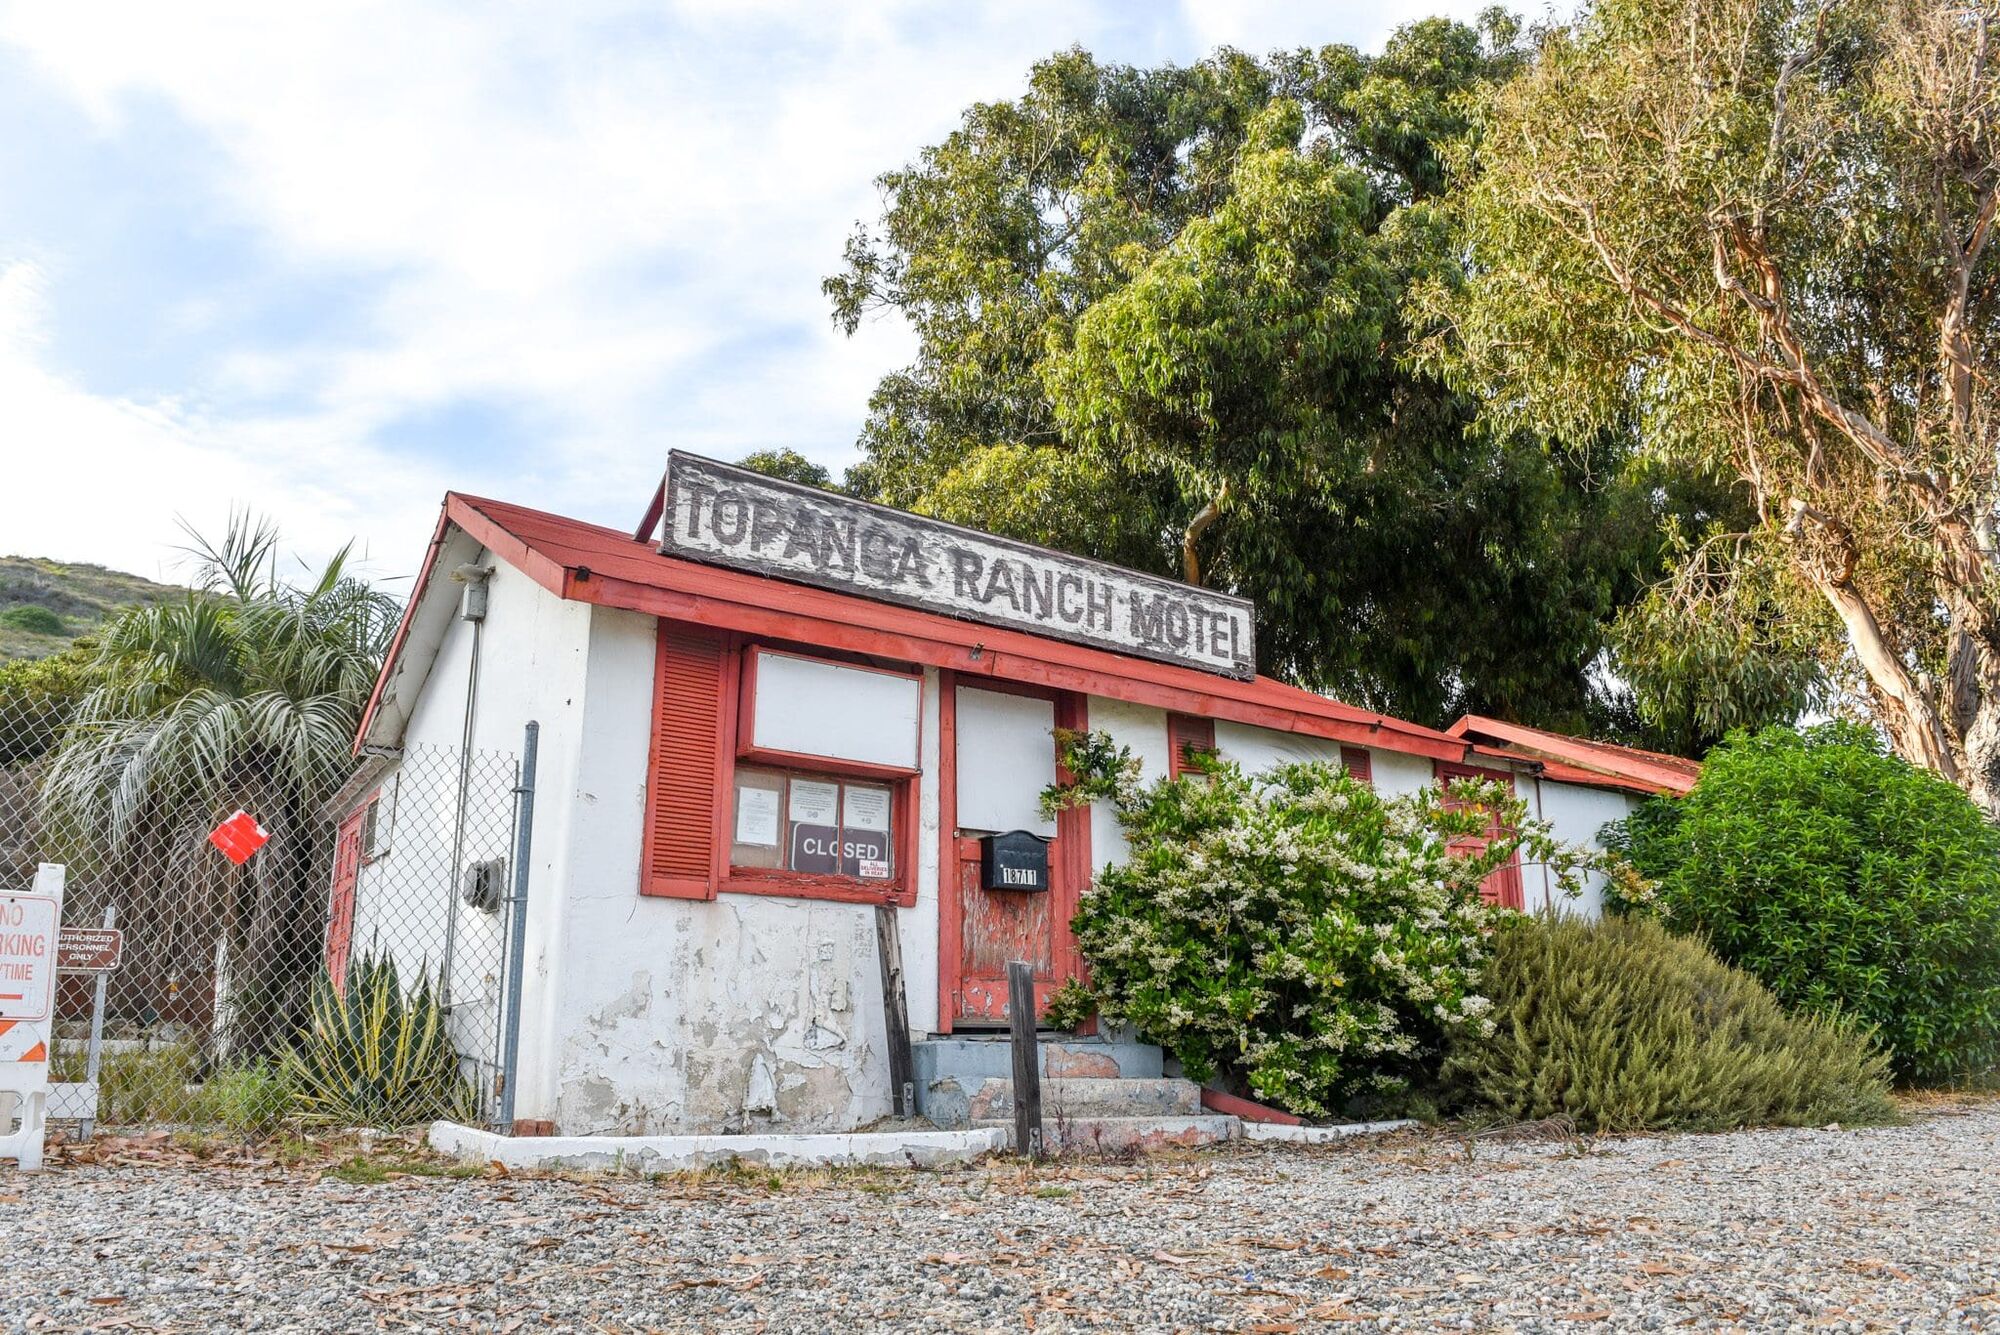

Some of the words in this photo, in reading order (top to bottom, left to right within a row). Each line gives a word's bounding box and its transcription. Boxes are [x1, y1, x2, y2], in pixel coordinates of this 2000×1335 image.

[952, 546, 1112, 632] RANCH
[1130, 589, 1250, 661] MOTEL
[803, 838, 879, 860] CLOSED
[1005, 869, 1035, 885] 18711
[0, 903, 23, 927] NO
[59, 934, 114, 943] UTHORIZED
[59, 943, 110, 952] ERSONNEL
[69, 953, 93, 961] ONLY
[0, 963, 33, 981] TIME
